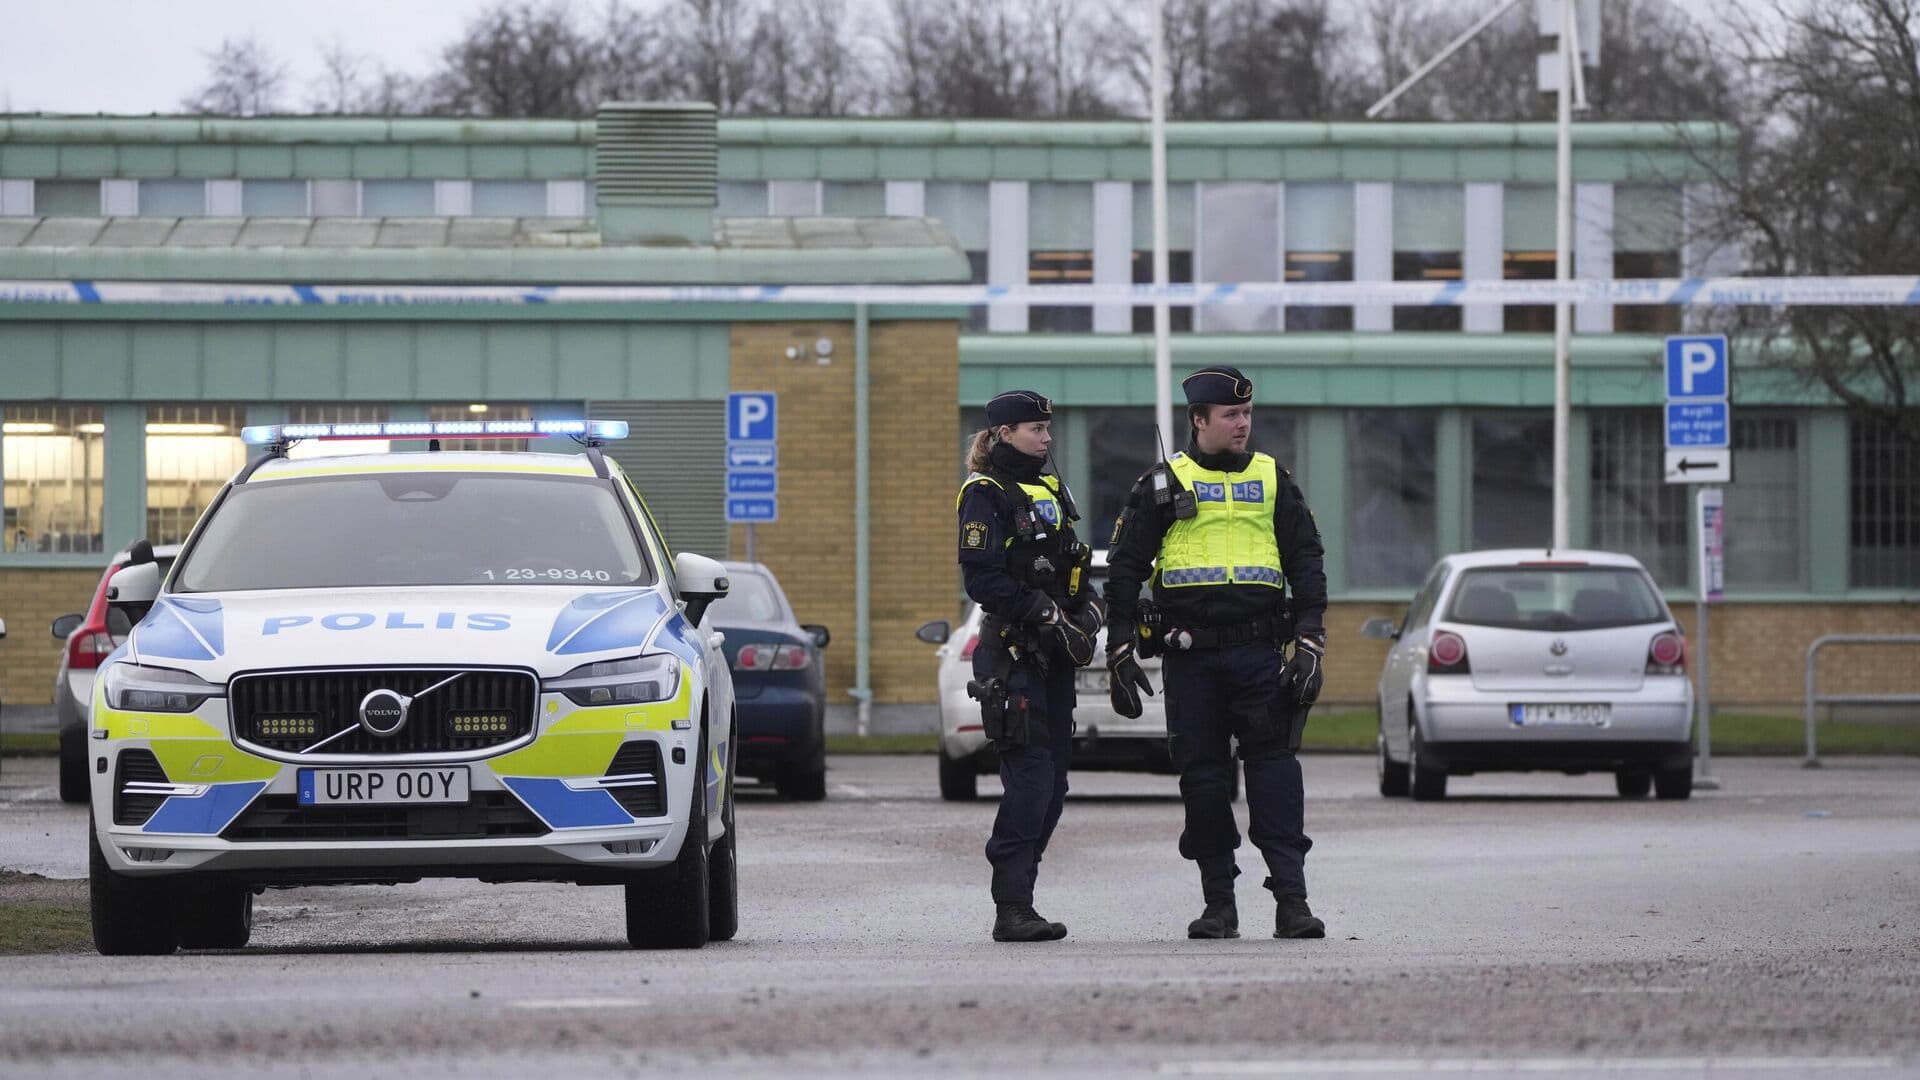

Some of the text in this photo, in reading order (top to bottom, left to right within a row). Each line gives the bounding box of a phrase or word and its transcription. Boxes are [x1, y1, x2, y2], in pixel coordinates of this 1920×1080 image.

[1682, 343, 1716, 393] P
[740, 397, 768, 437] P
[1195, 482, 1261, 500] POLIS
[966, 523, 986, 531] POLIS
[483, 568, 610, 581] 1 23-9340
[262, 612, 512, 635] POLIS
[304, 790, 310, 799] S
[326, 773, 384, 800] URP
